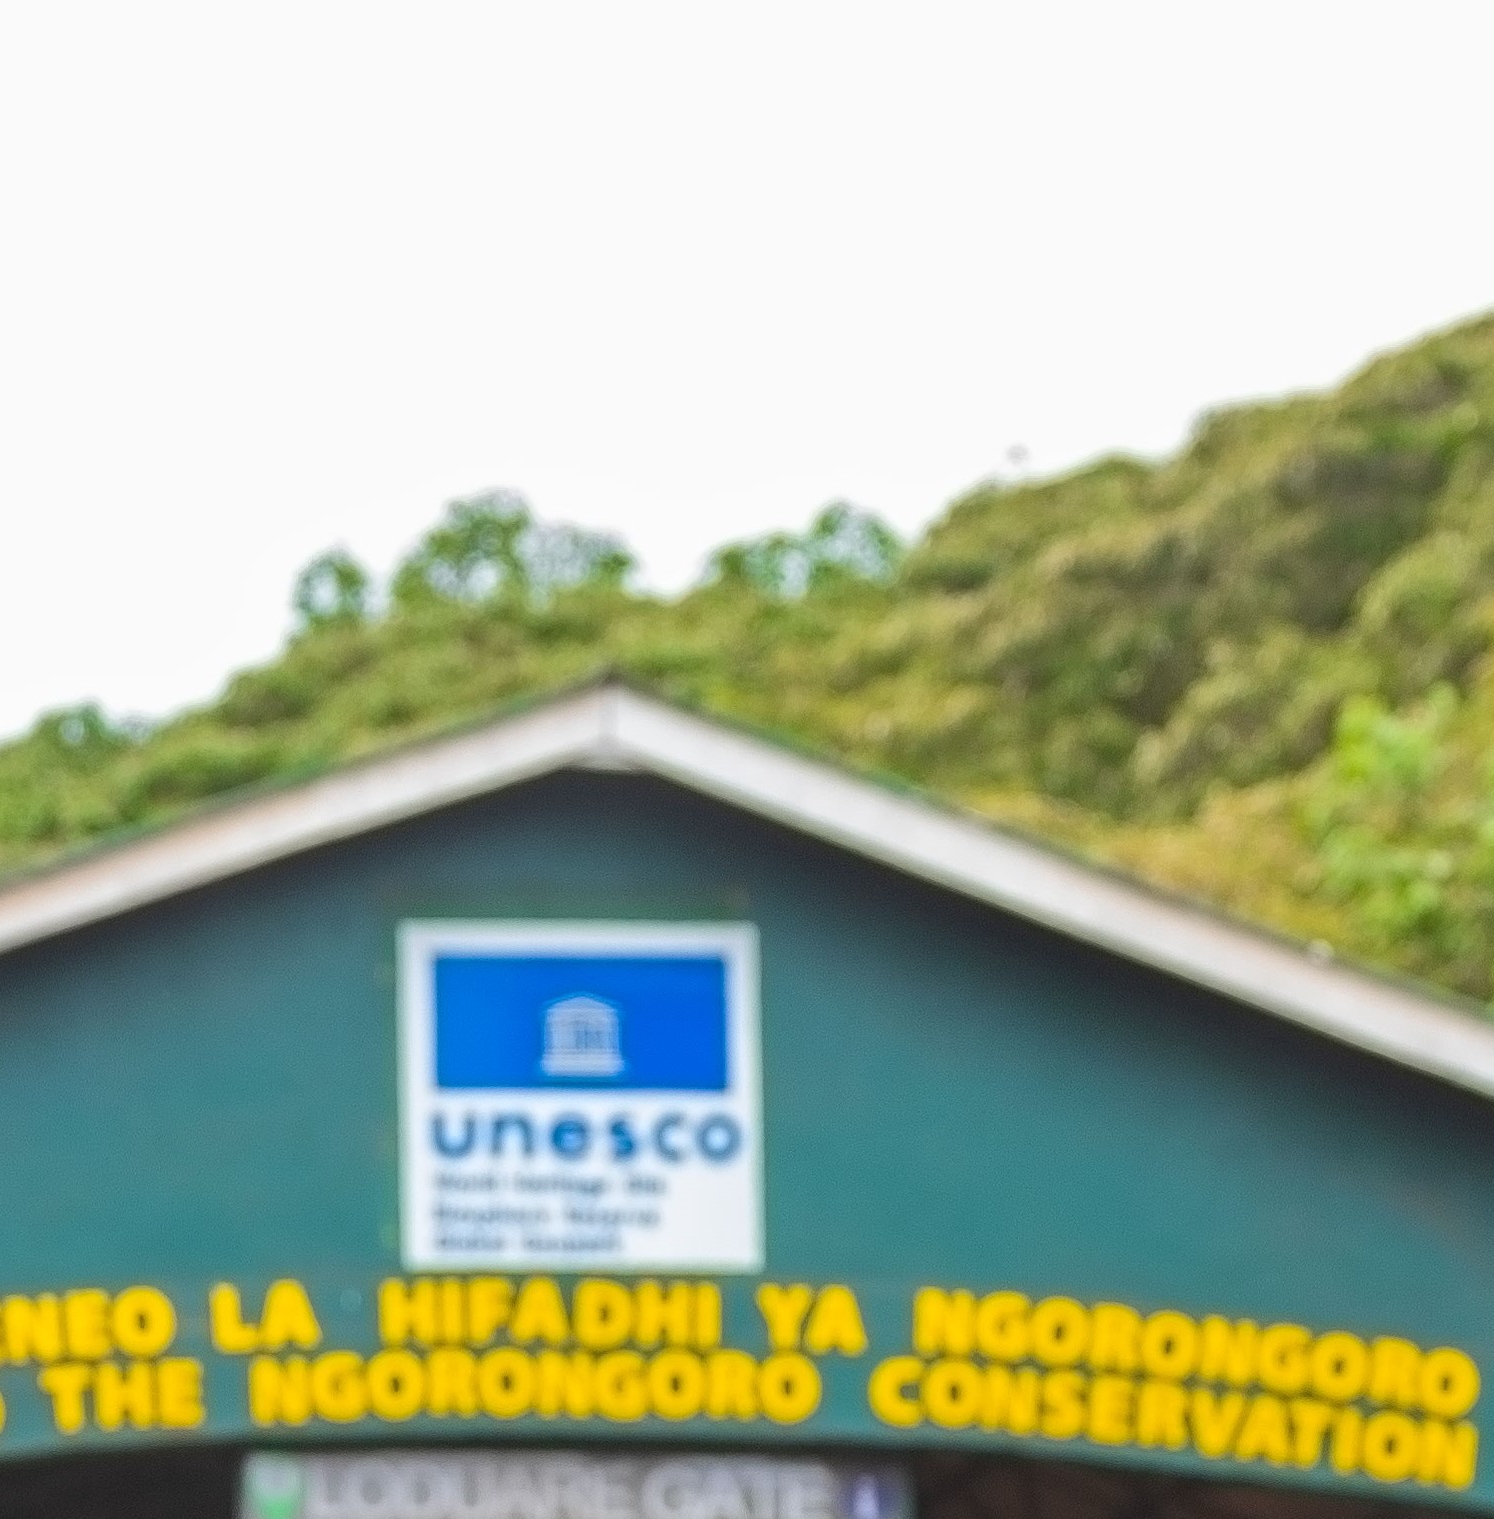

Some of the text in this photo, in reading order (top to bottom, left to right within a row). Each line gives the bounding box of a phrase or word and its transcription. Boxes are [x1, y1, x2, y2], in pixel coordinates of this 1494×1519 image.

[431, 1110, 741, 1163] unesco
[210, 1279, 322, 1354] LA
[379, 1276, 722, 1349] HIFADHI
[756, 1285, 868, 1357] YA
[913, 1286, 1480, 1420] NGORONGORO
[41, 1357, 205, 1431] THE
[250, 1349, 822, 1425] NGORONGORO
[869, 1354, 1479, 1490] CONSERVATION
